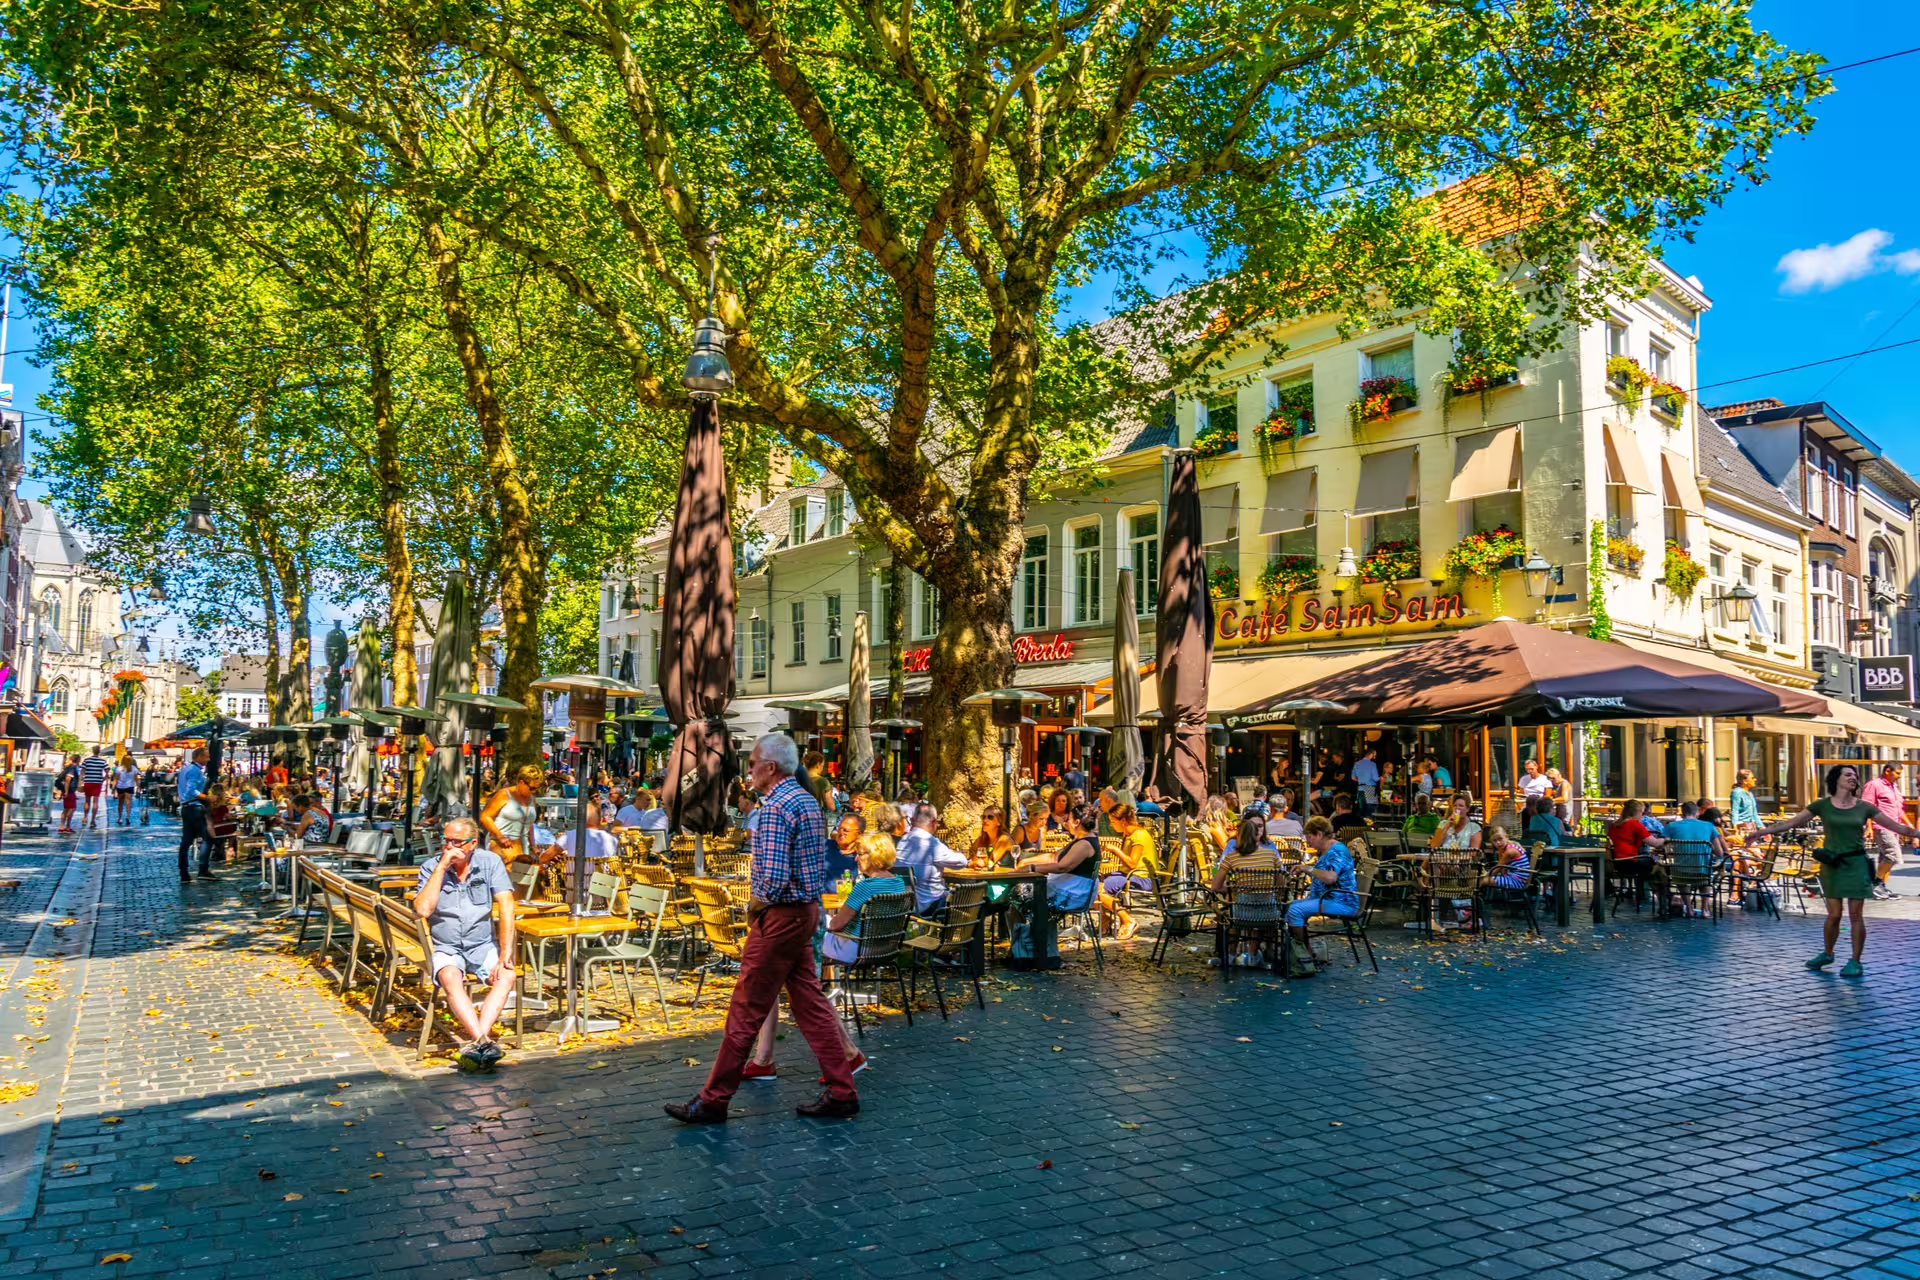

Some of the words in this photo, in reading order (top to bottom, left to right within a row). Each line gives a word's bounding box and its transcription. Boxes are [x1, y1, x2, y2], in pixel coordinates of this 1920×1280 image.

[1218, 600, 1289, 643] Café
[1013, 634, 1075, 662] Breda
[1865, 667, 1904, 685] BBB
